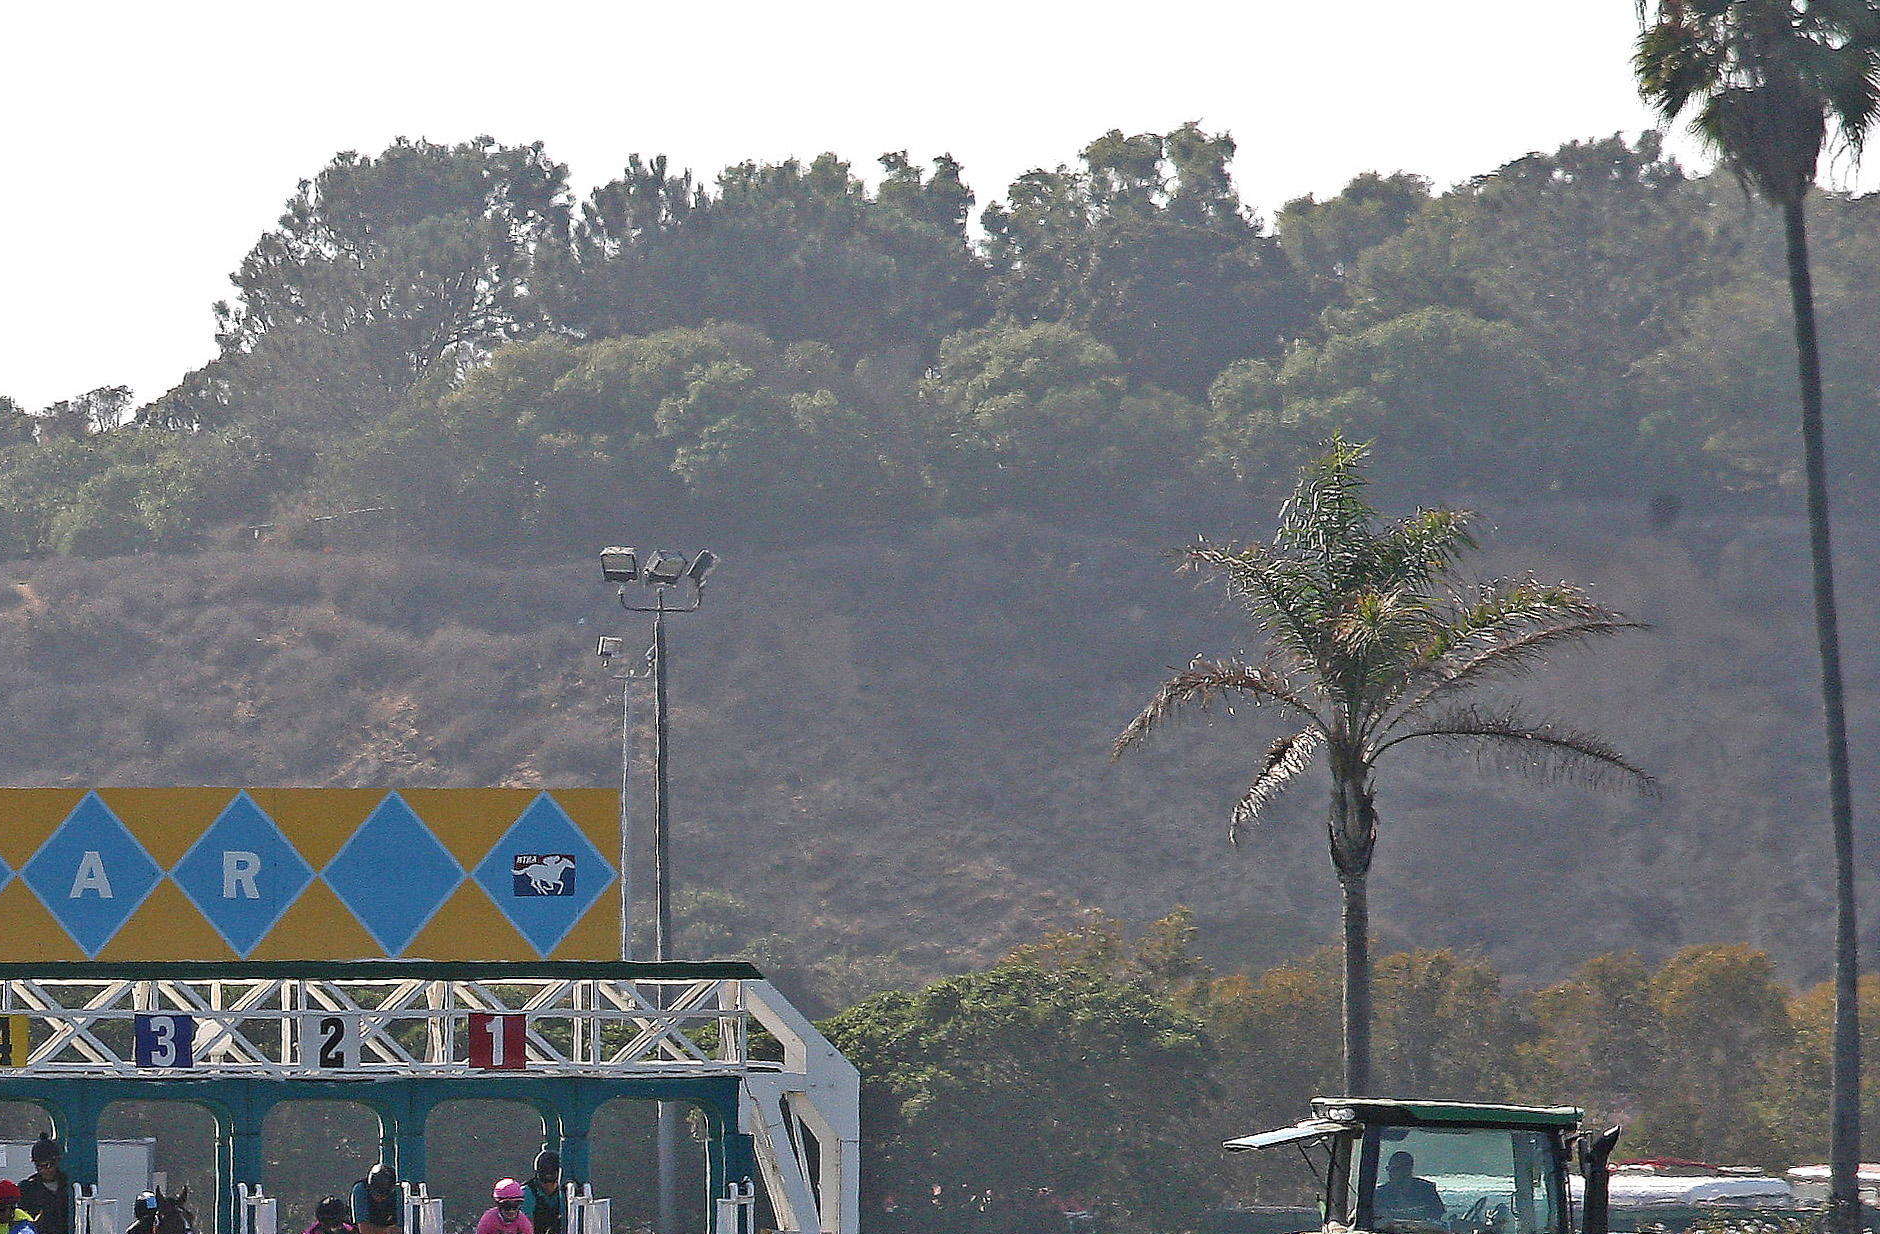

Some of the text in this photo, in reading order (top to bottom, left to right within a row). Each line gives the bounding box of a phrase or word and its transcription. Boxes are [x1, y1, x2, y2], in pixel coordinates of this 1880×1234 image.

[150, 1016, 176, 1067] 3
[320, 1017, 345, 1068] 2
[486, 1016, 504, 1066] 1
